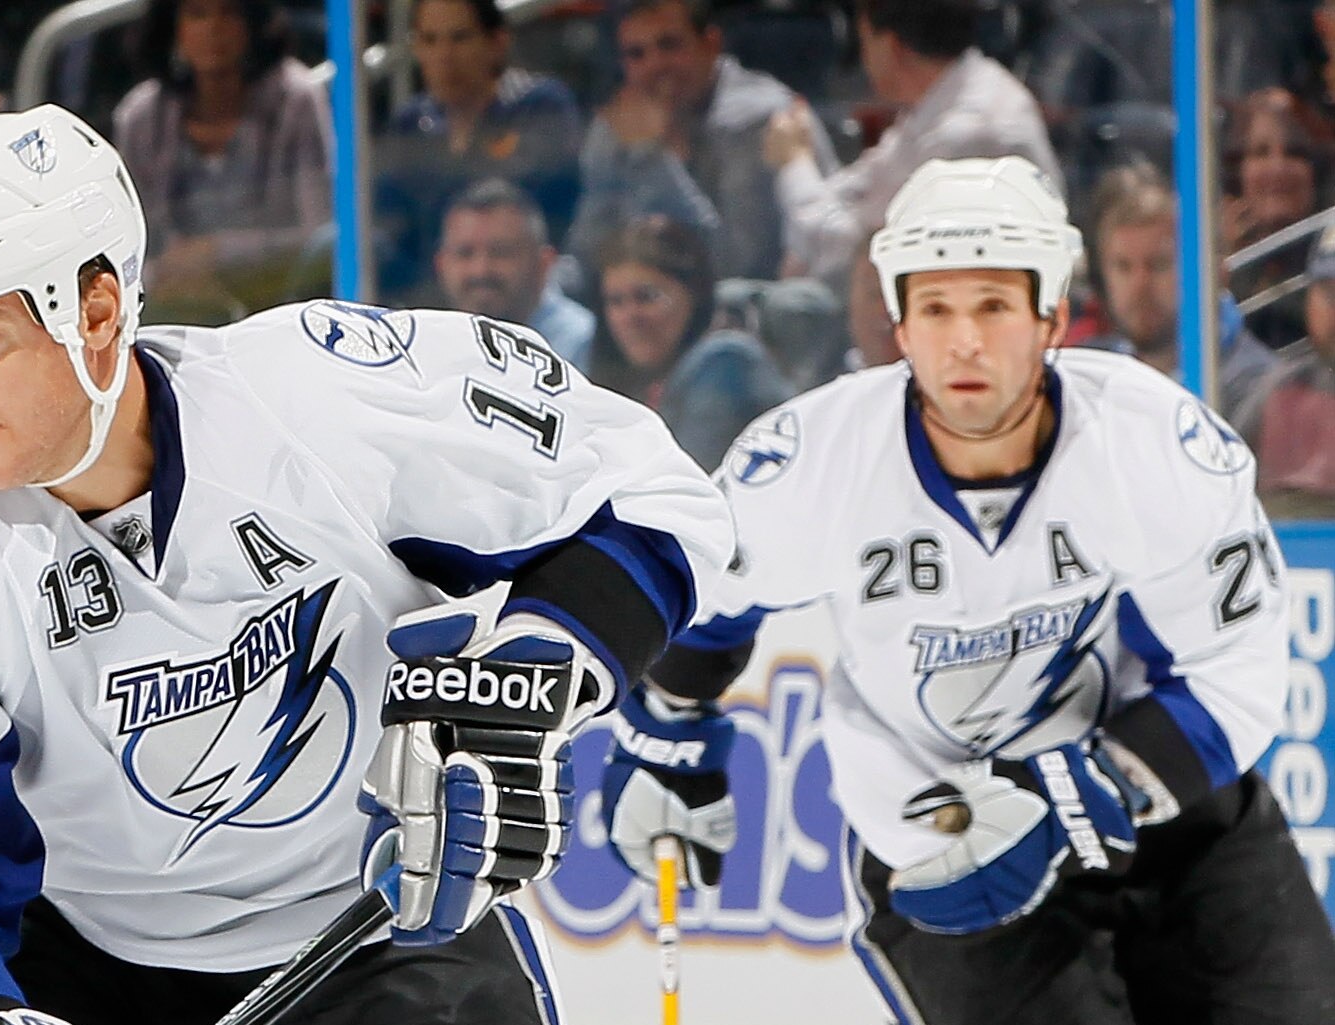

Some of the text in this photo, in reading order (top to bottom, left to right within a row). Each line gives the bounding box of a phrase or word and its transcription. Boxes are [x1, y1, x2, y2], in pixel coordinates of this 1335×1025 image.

[463, 315, 570, 462] 13
[229, 512, 318, 592] A
[861, 528, 950, 604] 26
[1047, 521, 1098, 588] A
[38, 547, 124, 649] 13
[910, 603, 1086, 671] TAMPA BAY
[110, 598, 297, 731] TAMPA BAY
[385, 660, 559, 714] Reebok
